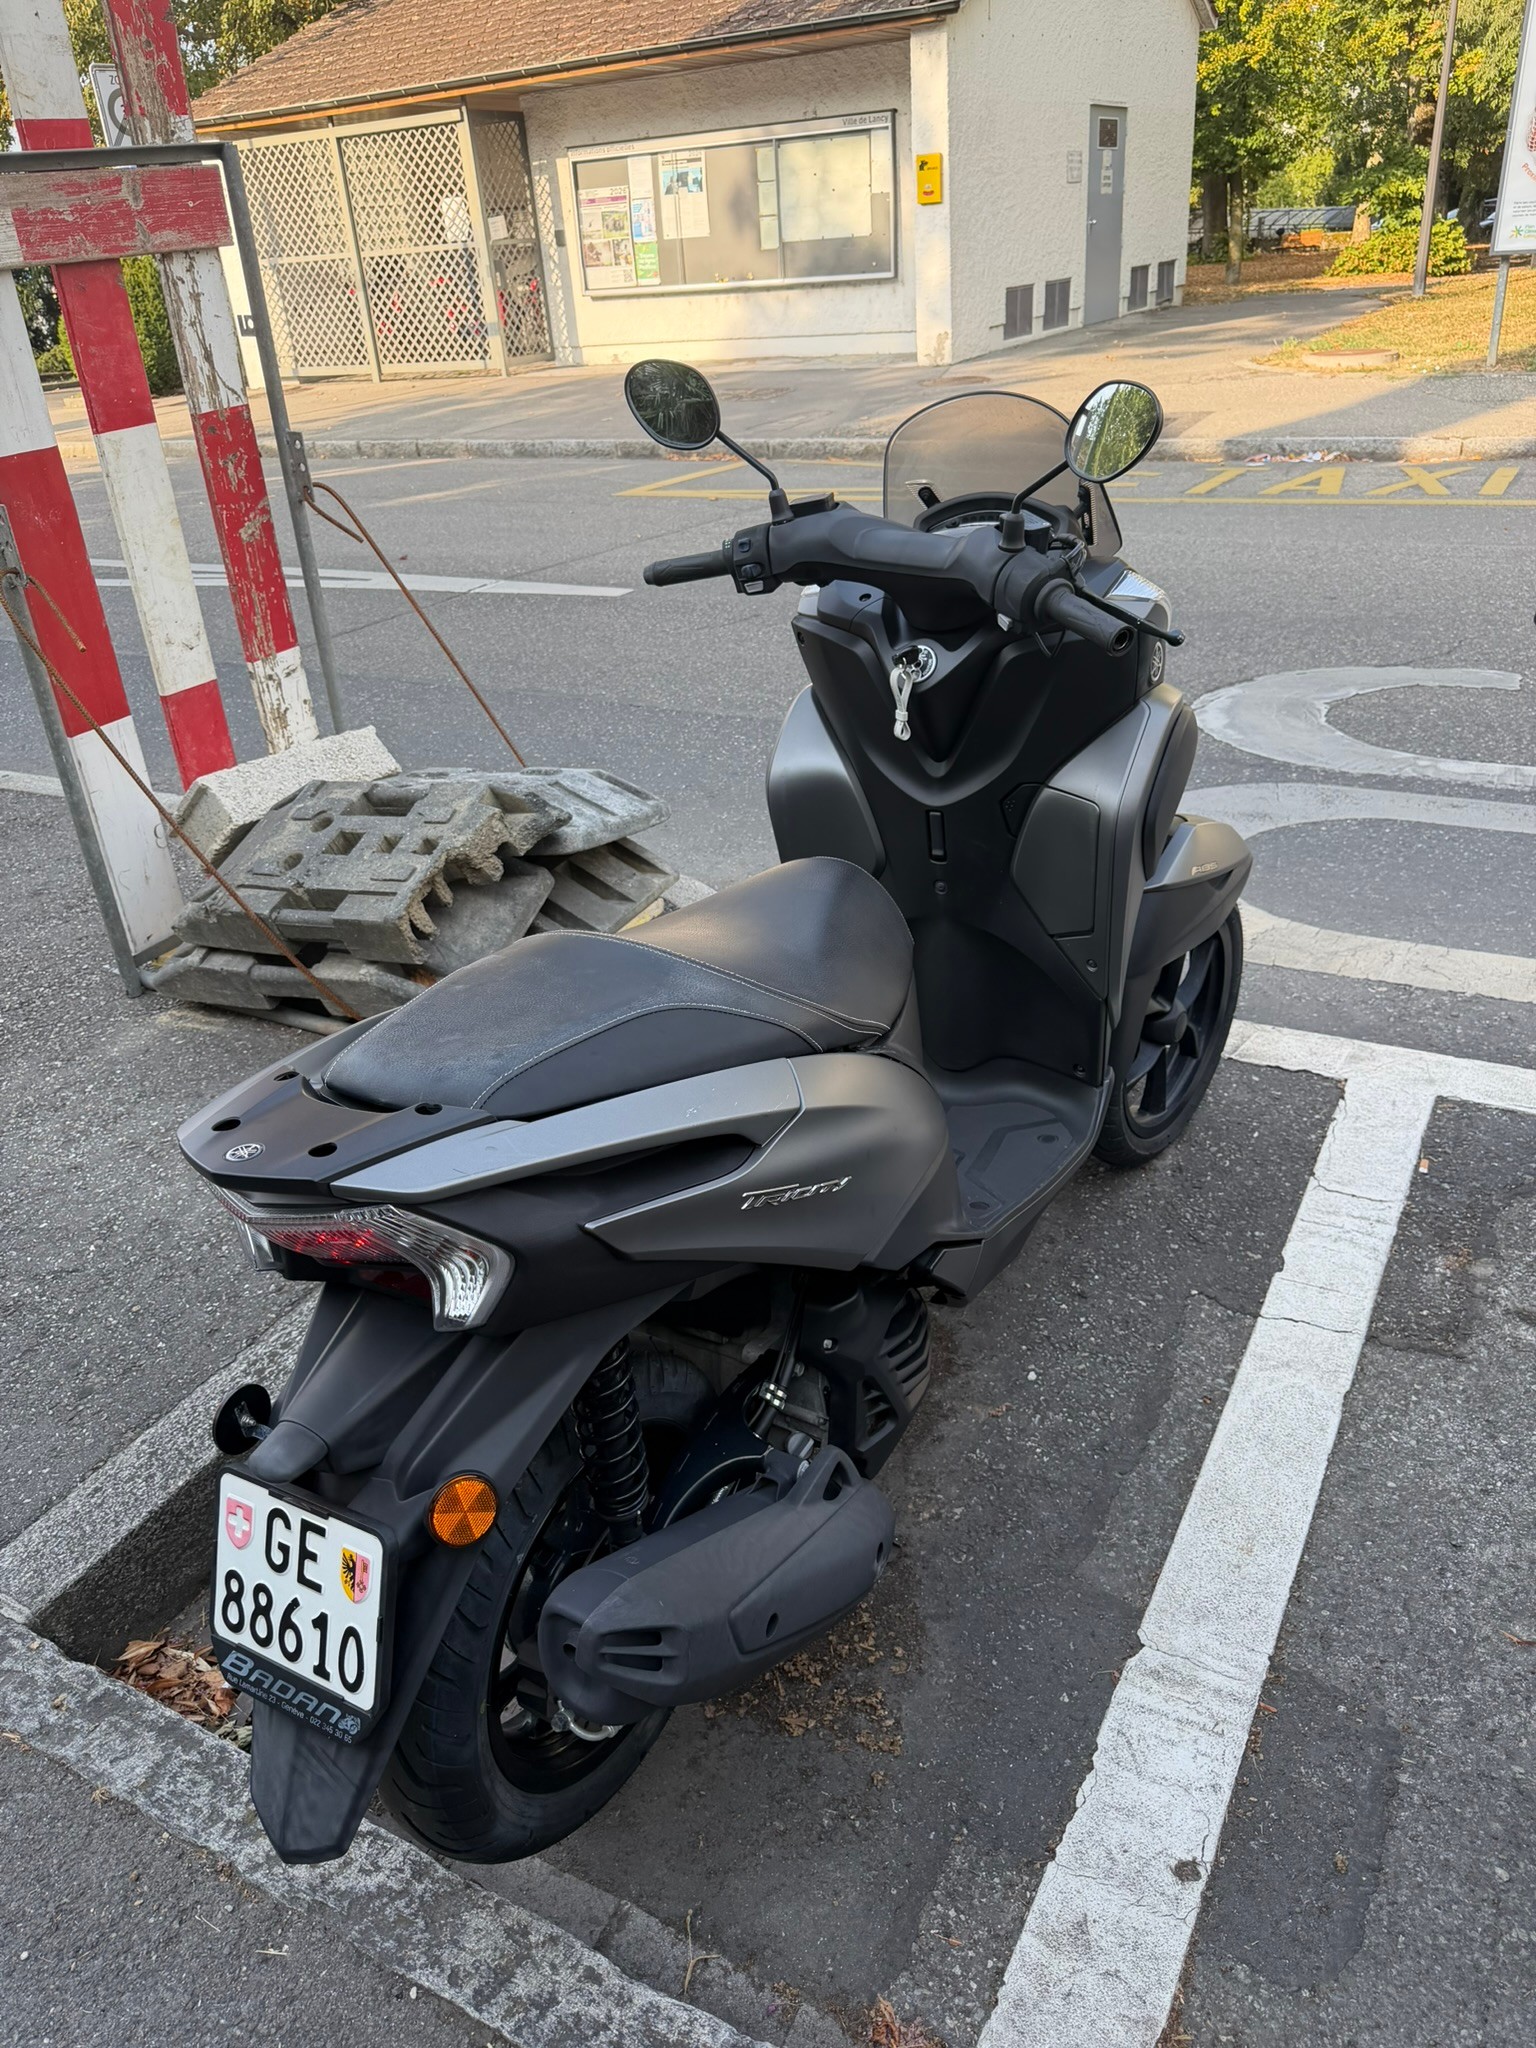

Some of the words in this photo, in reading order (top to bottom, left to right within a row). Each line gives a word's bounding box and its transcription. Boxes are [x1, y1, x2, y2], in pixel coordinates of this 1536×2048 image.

[841, 117, 858, 126] Ville
[858, 116, 868, 124] de
[868, 114, 889, 123] Lancy
[1184, 467, 1519, 496] TAXI
[265, 1507, 327, 1594] GE
[221, 1569, 365, 1693] 88610
[221, 1650, 341, 1724] BADAN
[268, 1694, 277, 1704] 23
[309, 1716, 321, 1728] 022
[322, 1722, 334, 1734] 345
[334, 1728, 343, 1739] 30
